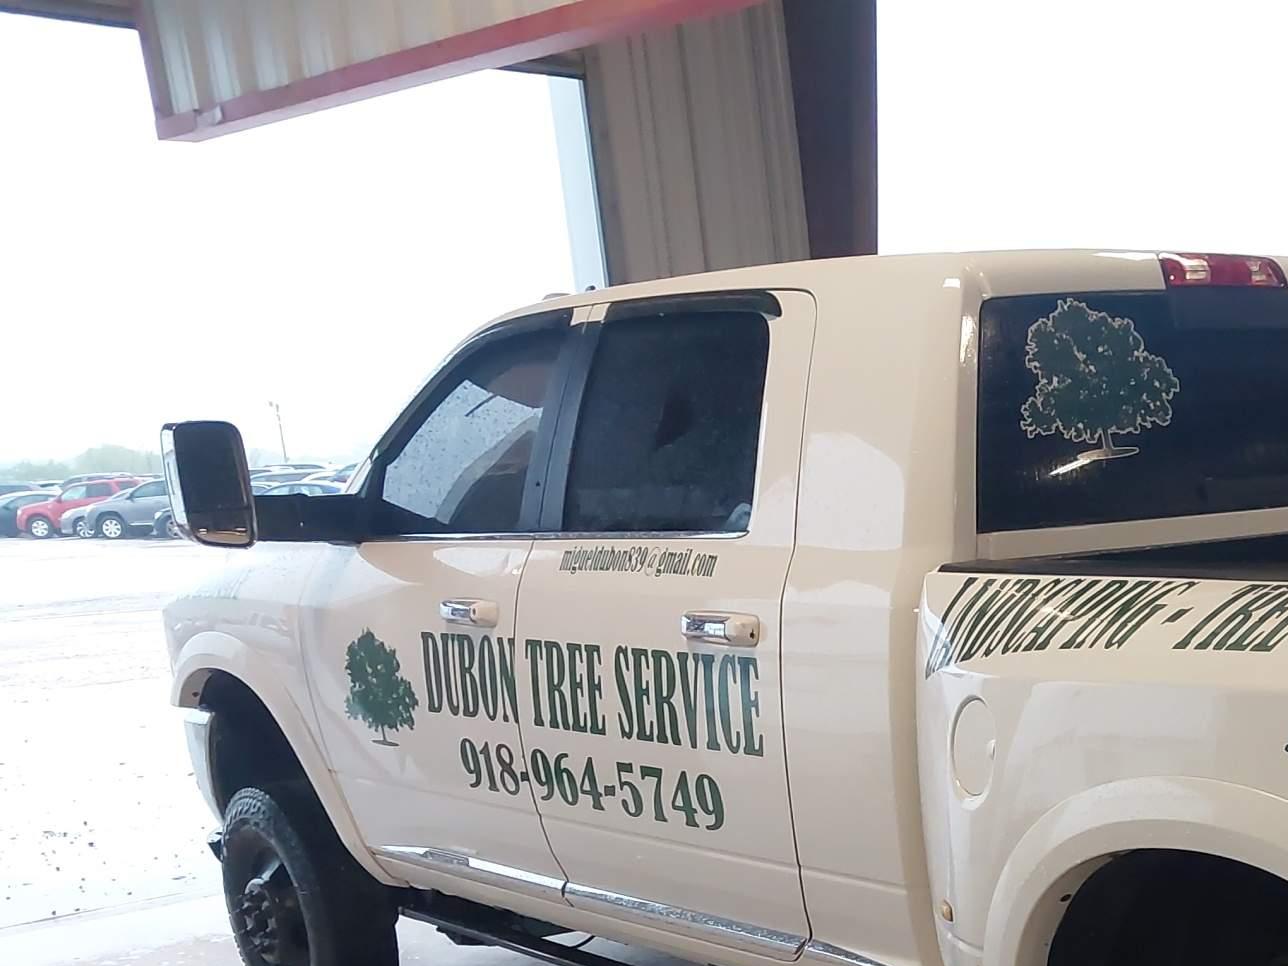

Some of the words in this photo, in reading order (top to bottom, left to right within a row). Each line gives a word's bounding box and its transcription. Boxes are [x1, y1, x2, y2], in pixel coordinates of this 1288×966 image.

[559, 546, 718, 577] migueldubon839@gmail.com
[925, 577, 1201, 680] LANDSCAPING
[420, 631, 520, 724] DUBON
[525, 639, 608, 736] TREE
[613, 645, 765, 757] SERVICE
[460, 737, 725, 832] 918-964-5749
